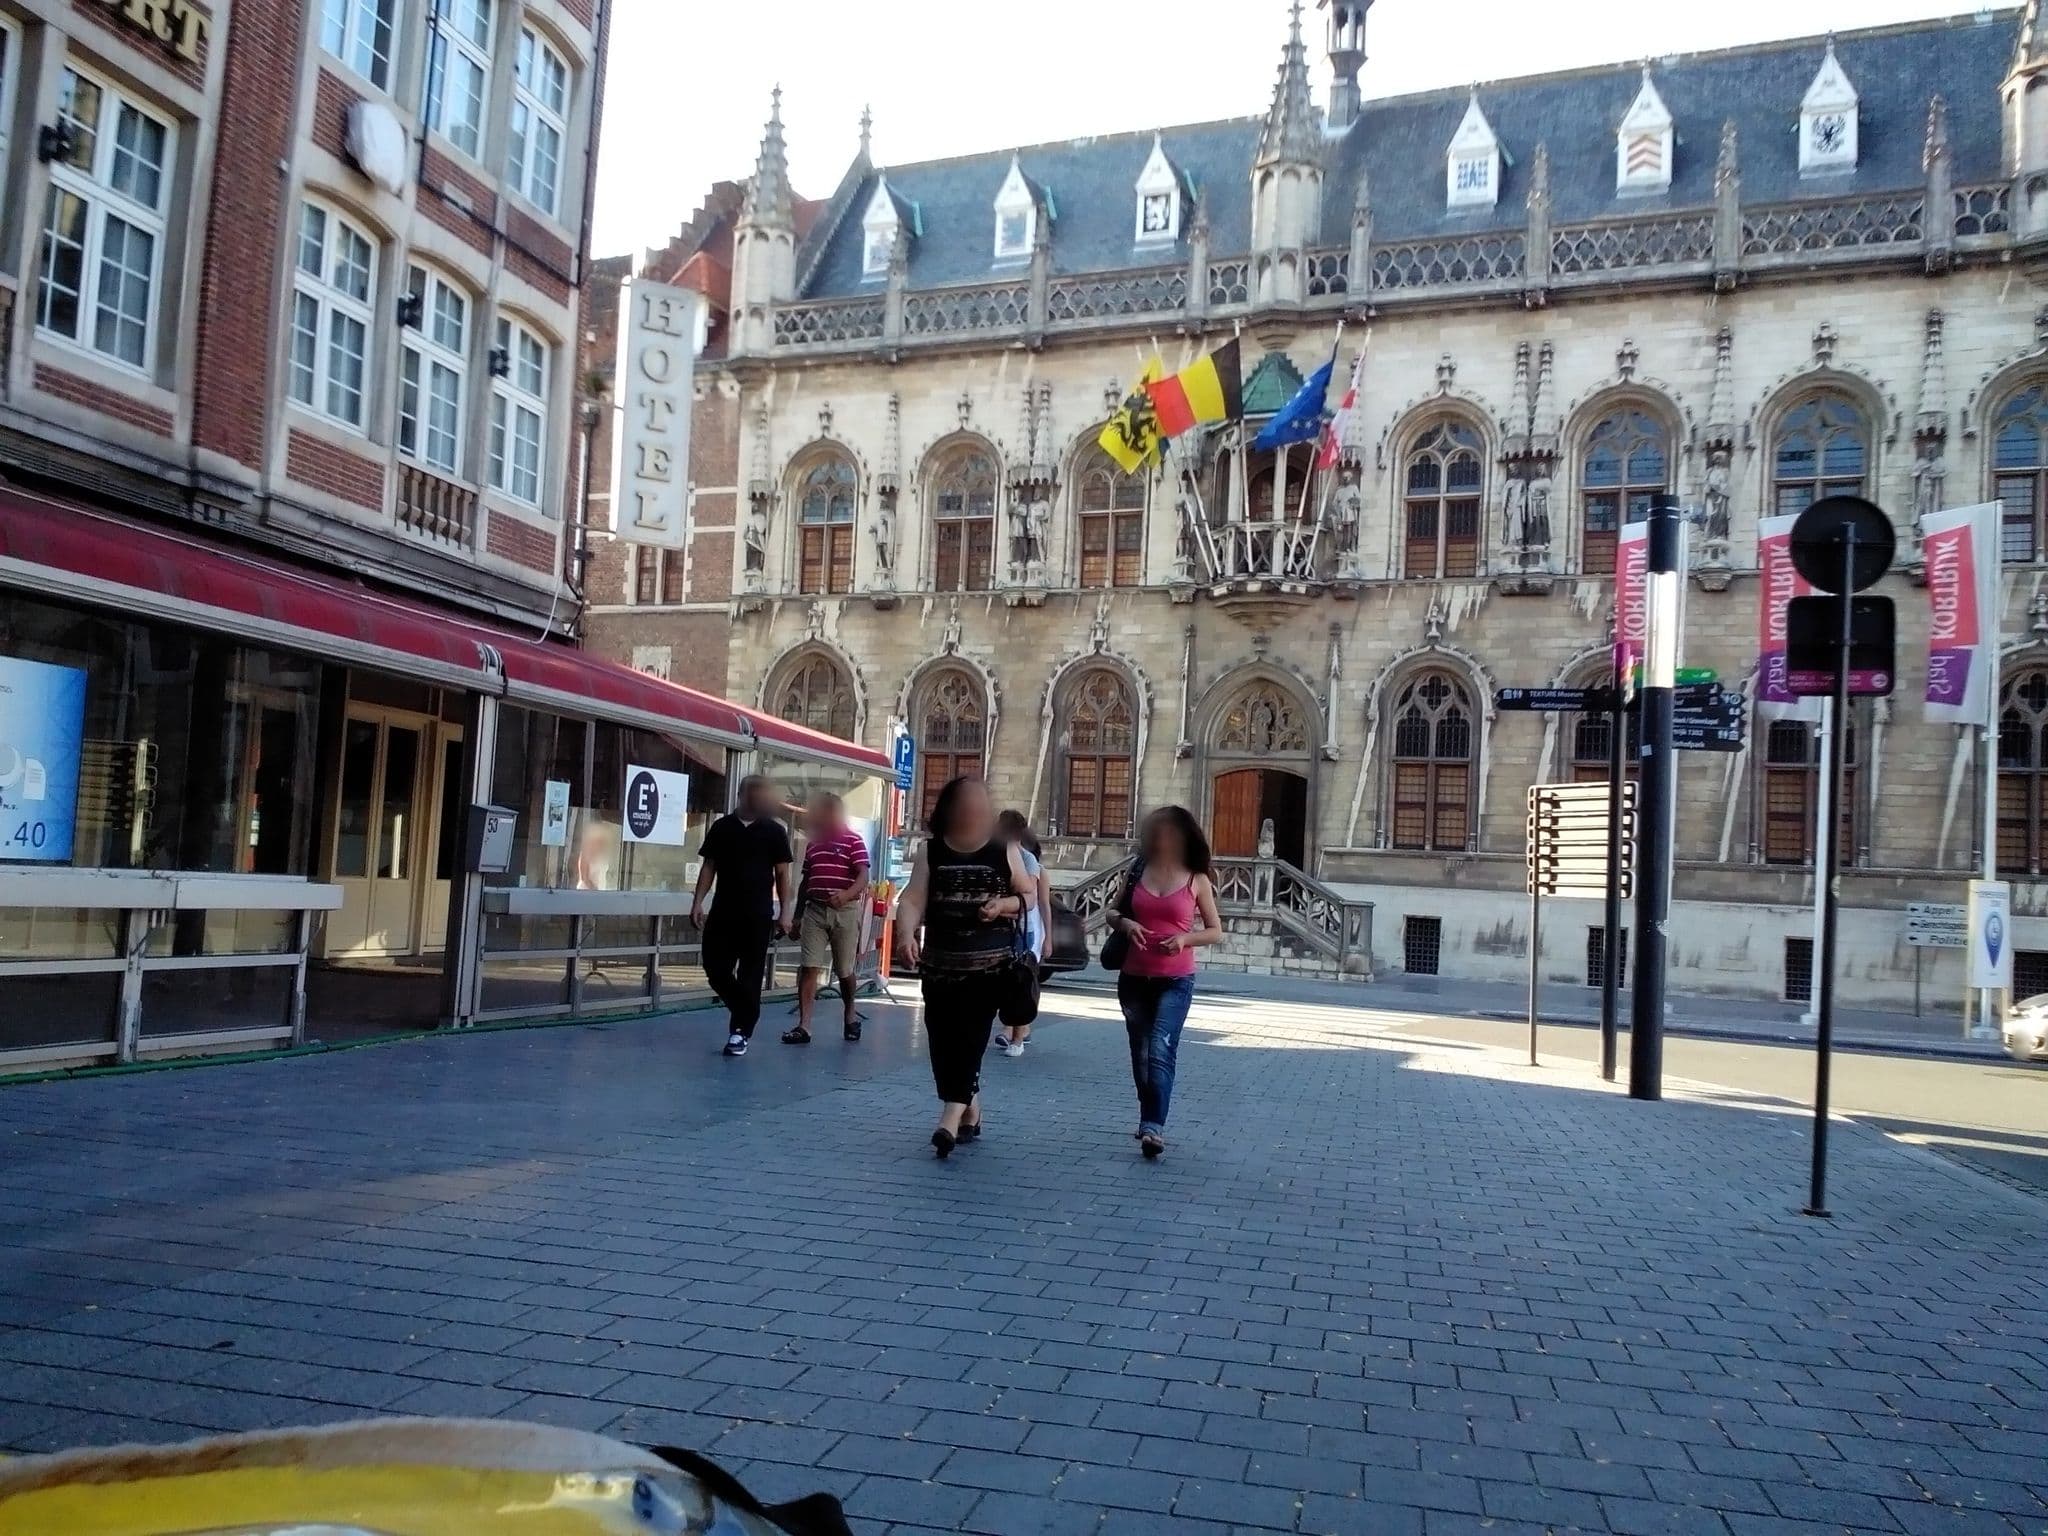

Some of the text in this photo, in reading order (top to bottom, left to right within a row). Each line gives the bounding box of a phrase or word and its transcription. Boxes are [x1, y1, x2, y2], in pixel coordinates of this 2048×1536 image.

[635, 293, 684, 532] HOTEL
[1529, 690, 1584, 698] TEXTURE Museum
[901, 740, 910, 763] P
[487, 817, 498, 833] 53
[1924, 905, 1956, 916] Appel
